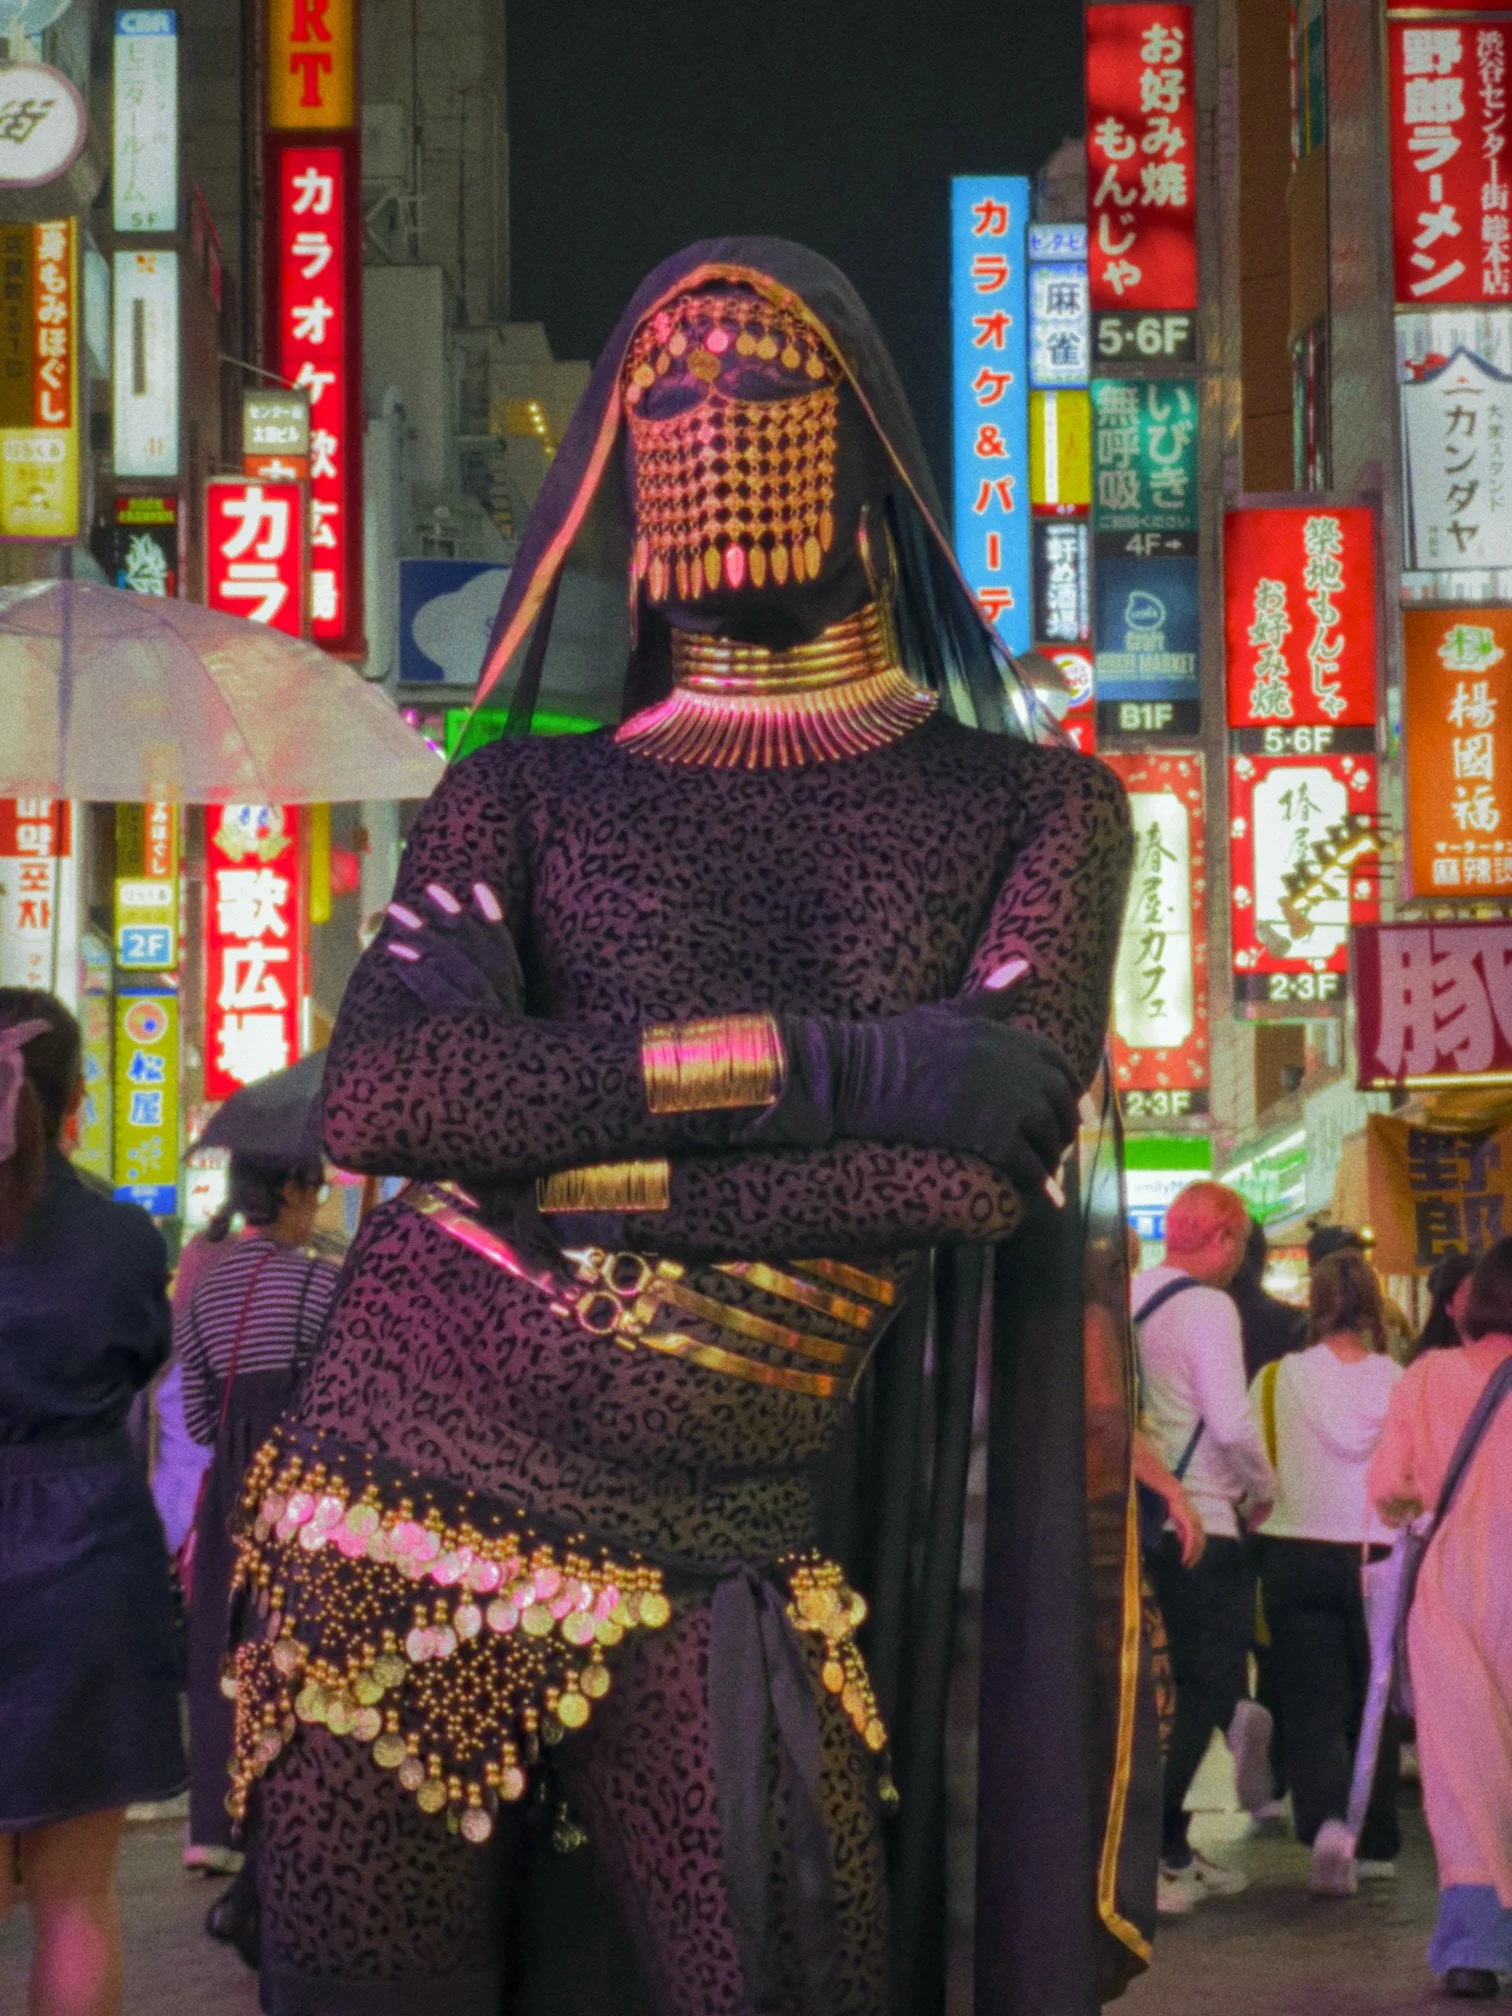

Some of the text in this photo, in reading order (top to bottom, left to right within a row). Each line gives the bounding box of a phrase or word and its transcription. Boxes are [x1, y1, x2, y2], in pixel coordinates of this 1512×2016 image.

[1140, 22, 1187, 207] お好み焼
[1403, 28, 1467, 298] 野郎ラーメン
[1094, 115, 1143, 297] もんじゃ
[1046, 281, 1081, 366] 麻雀
[1097, 384, 1141, 510] 無呼吸
[1147, 384, 1193, 509] いびき
[1444, 404, 1480, 552] カンダヤ
[1125, 532, 1162, 556] 4F
[1248, 577, 1294, 719] お好み焼
[1303, 515, 1347, 719] 築地もんじゃ
[1120, 703, 1174, 730] B1F
[127, 934, 165, 957] 2F
